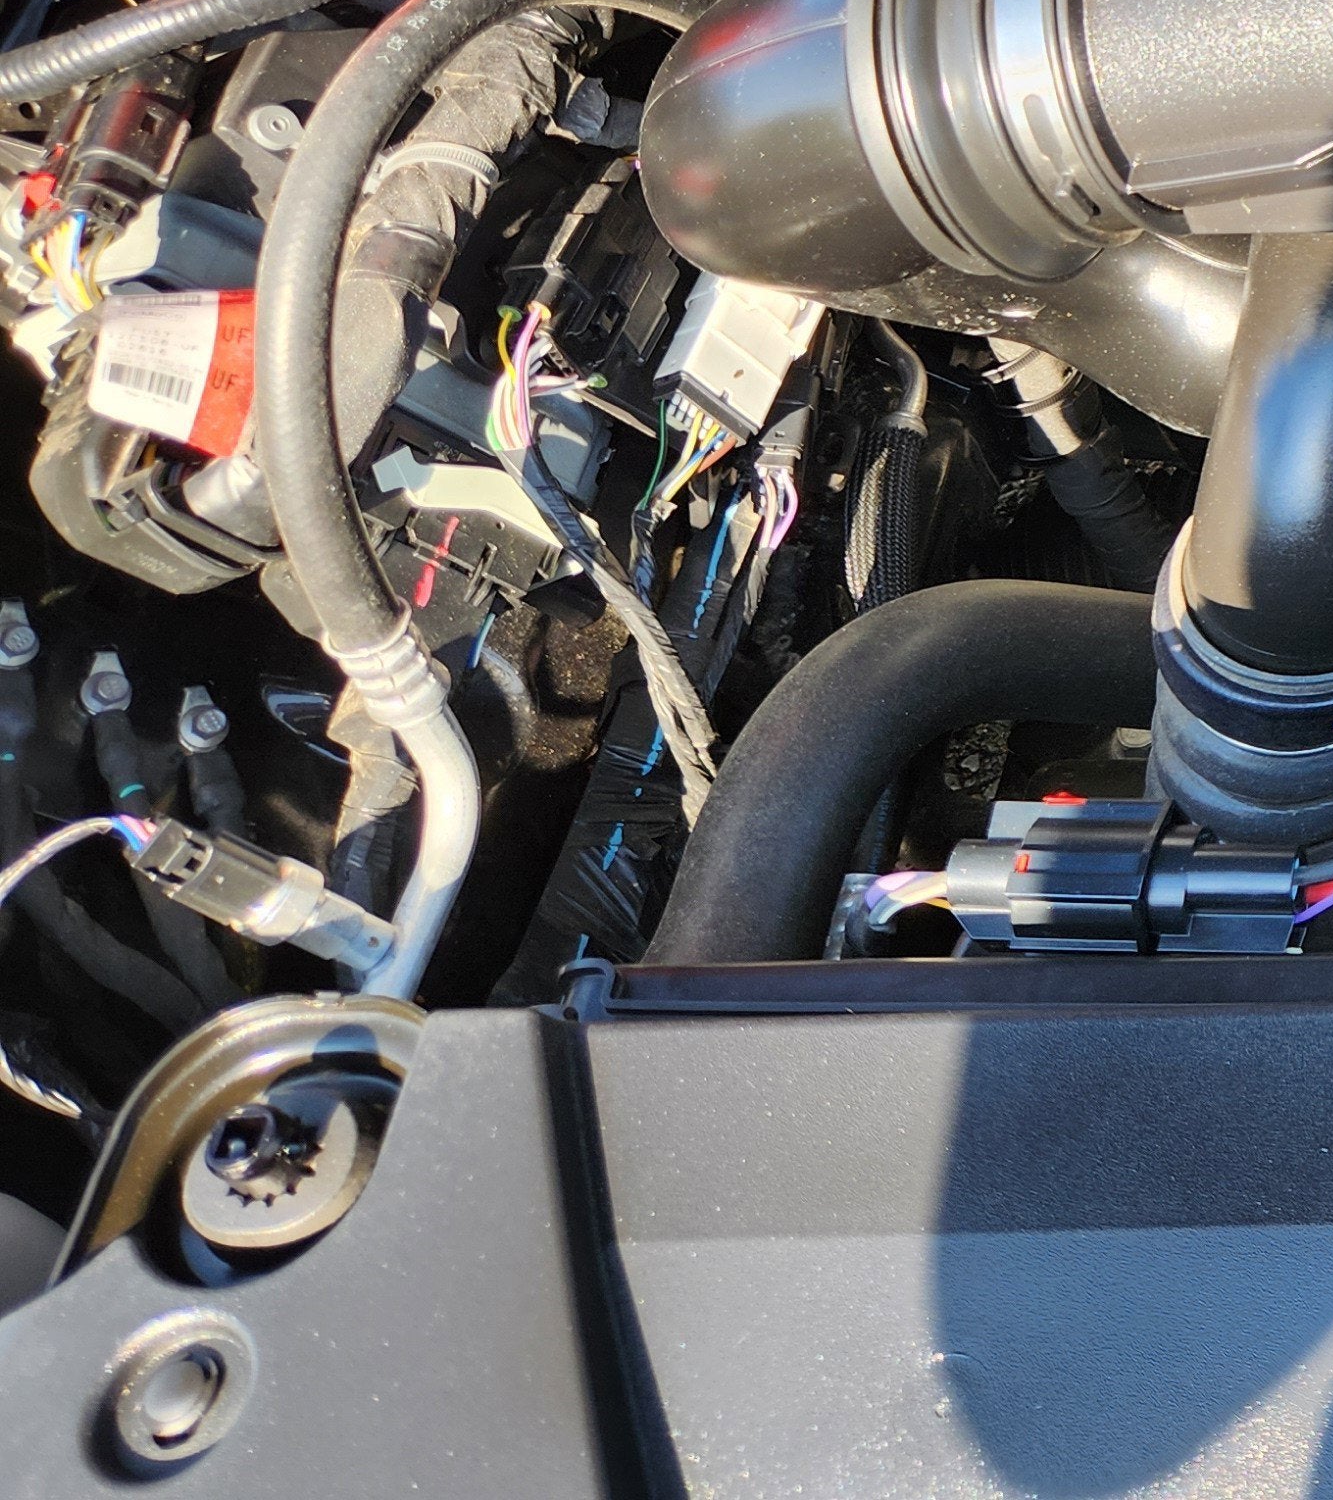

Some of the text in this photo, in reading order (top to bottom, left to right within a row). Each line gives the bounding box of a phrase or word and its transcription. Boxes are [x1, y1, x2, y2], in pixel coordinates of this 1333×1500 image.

[406, 13, 430, 31] PA
[221, 325, 251, 344] UF
[211, 368, 240, 392] UF
